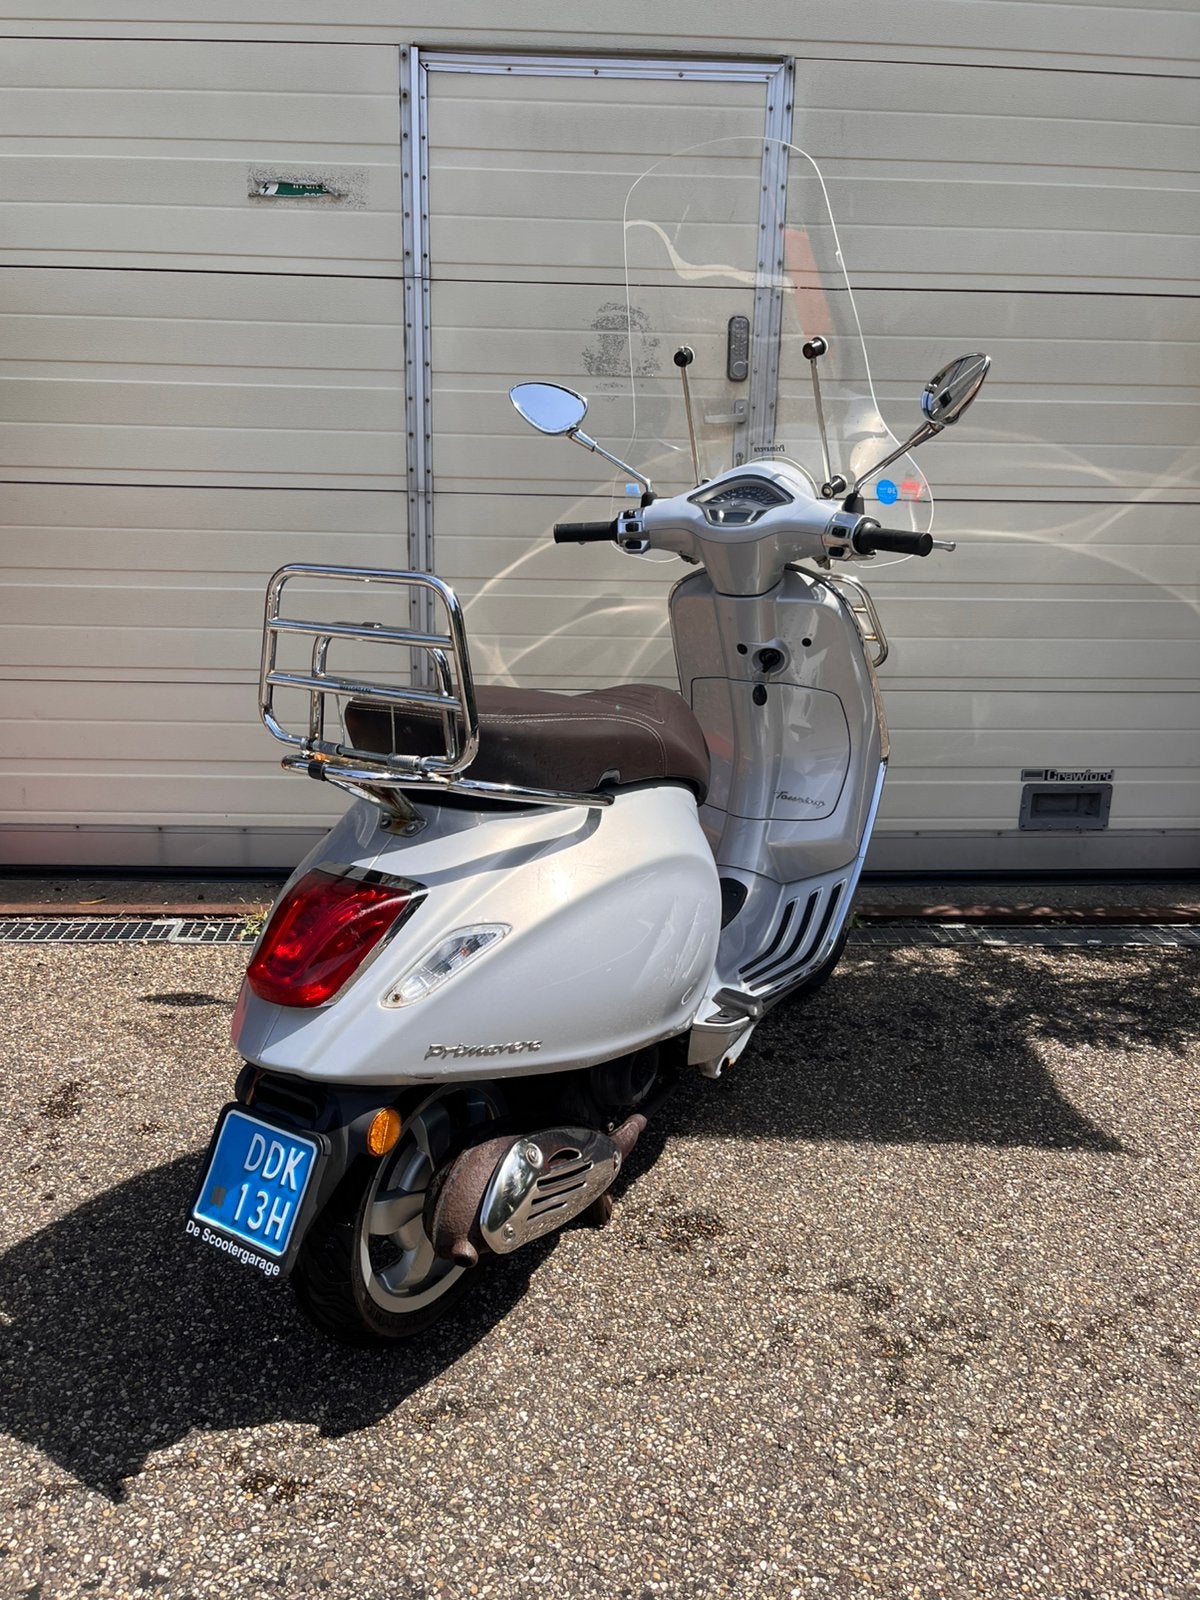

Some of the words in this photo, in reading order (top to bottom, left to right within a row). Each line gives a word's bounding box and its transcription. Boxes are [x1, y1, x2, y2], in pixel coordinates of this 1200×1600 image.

[1047, 769, 1114, 782] Crawford
[424, 1040, 543, 1061] Primavera
[243, 1133, 306, 1190] DDK
[234, 1183, 291, 1240] 13H
[186, 1220, 200, 1237] De
[202, 1227, 280, 1276] Scootergarage
